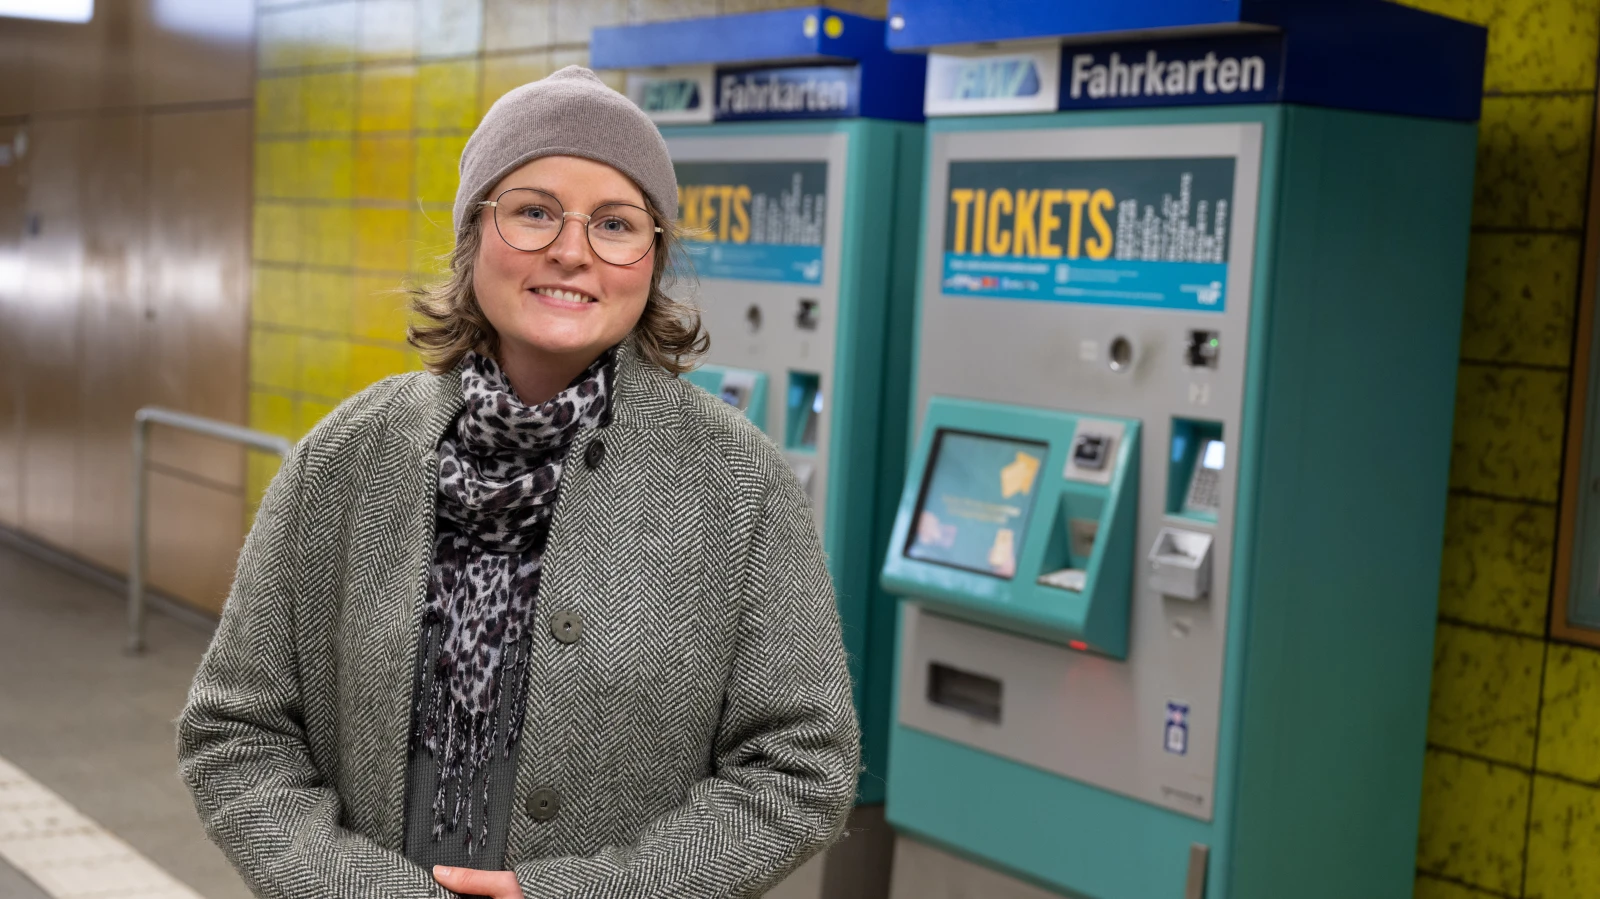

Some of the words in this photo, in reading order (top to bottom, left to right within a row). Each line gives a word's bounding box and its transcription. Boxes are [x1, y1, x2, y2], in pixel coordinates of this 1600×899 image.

[720, 74, 848, 113] Fahrkarten
[1070, 50, 1265, 99] Fahrkarten
[951, 188, 1116, 261] TICKETS
